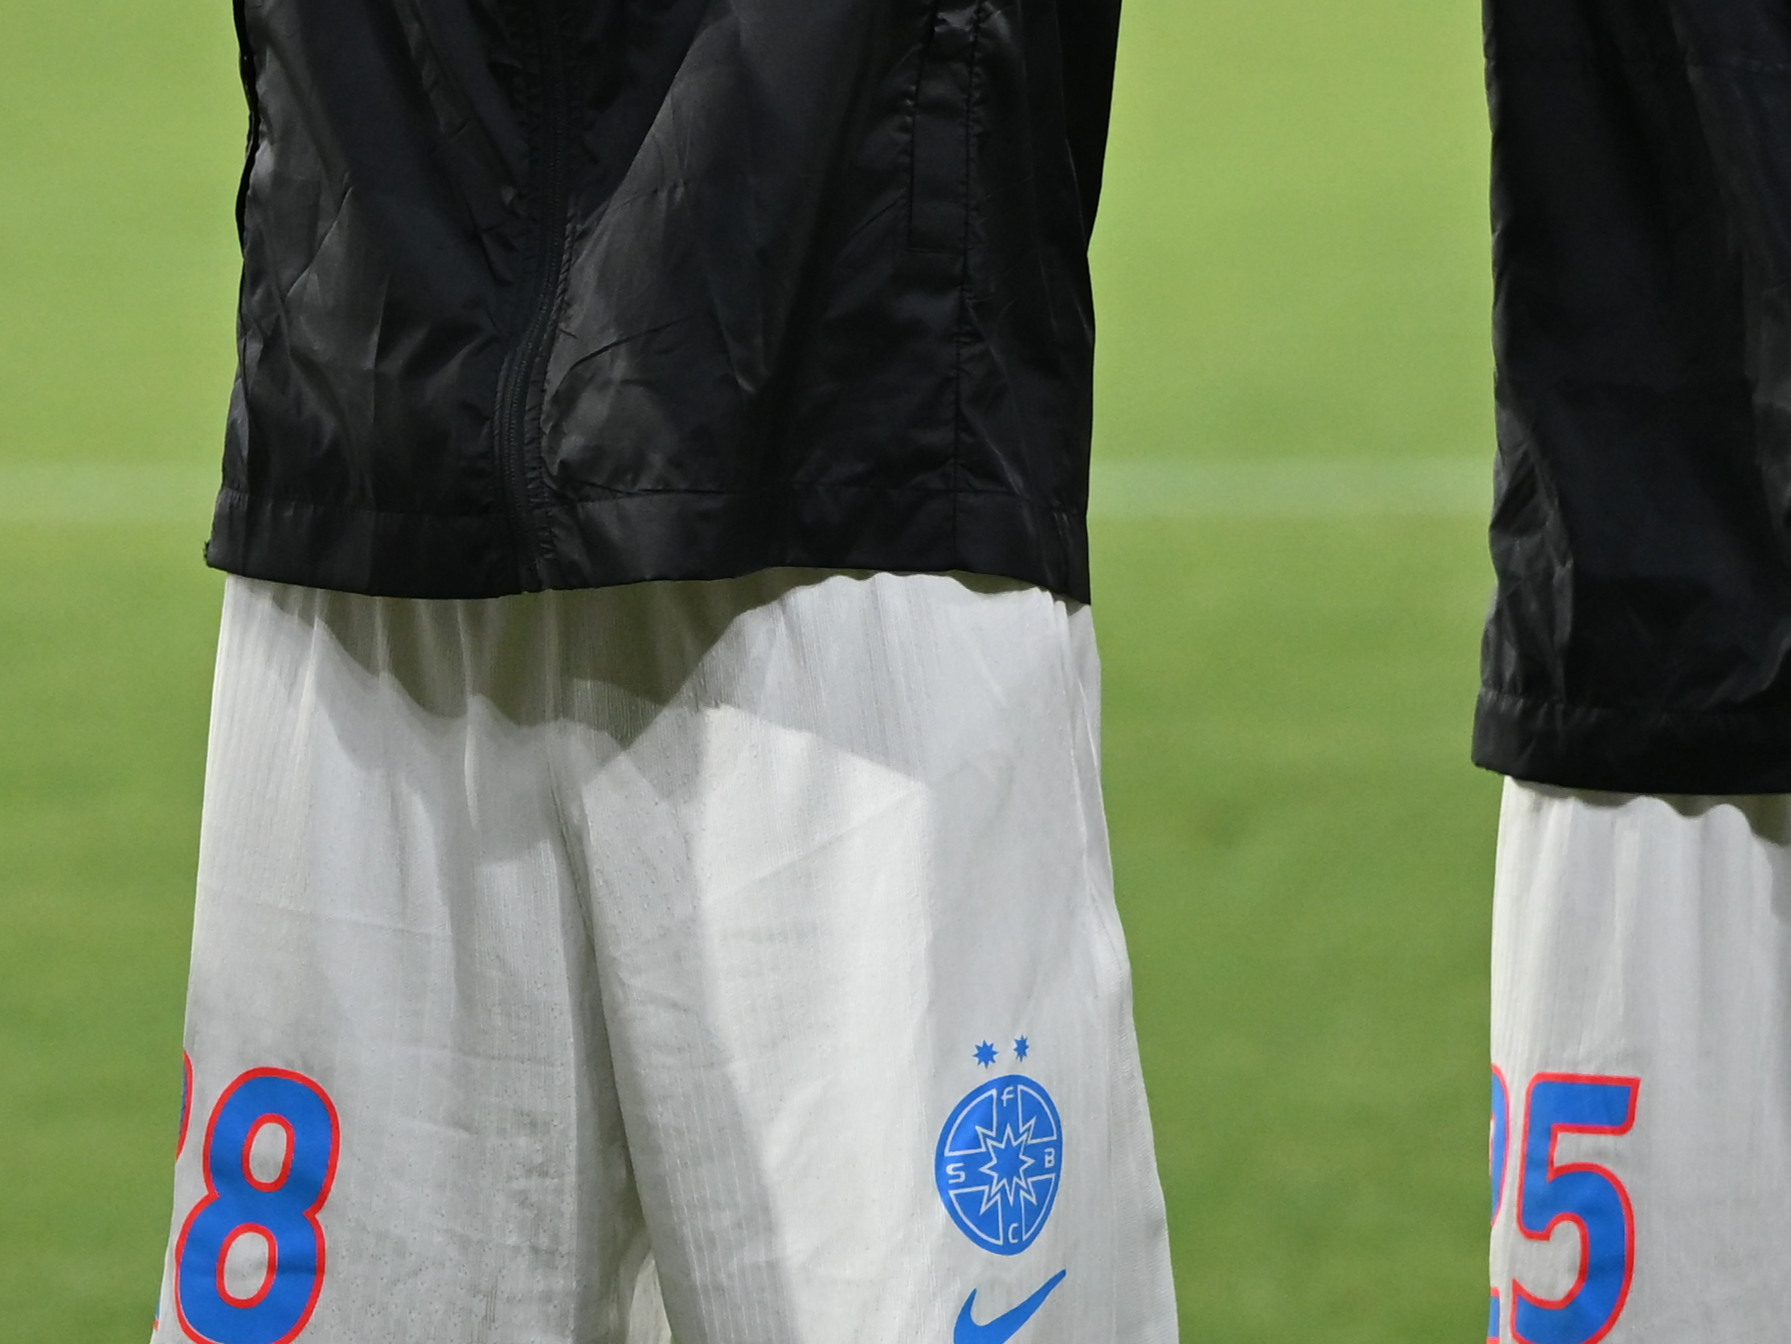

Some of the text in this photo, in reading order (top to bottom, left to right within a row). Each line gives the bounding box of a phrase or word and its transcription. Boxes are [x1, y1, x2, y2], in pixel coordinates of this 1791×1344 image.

[1043, 1147, 1056, 1170] B
[945, 1162, 966, 1185] S
[153, 1049, 340, 1344] 8
[1008, 1222, 1020, 1244] C
